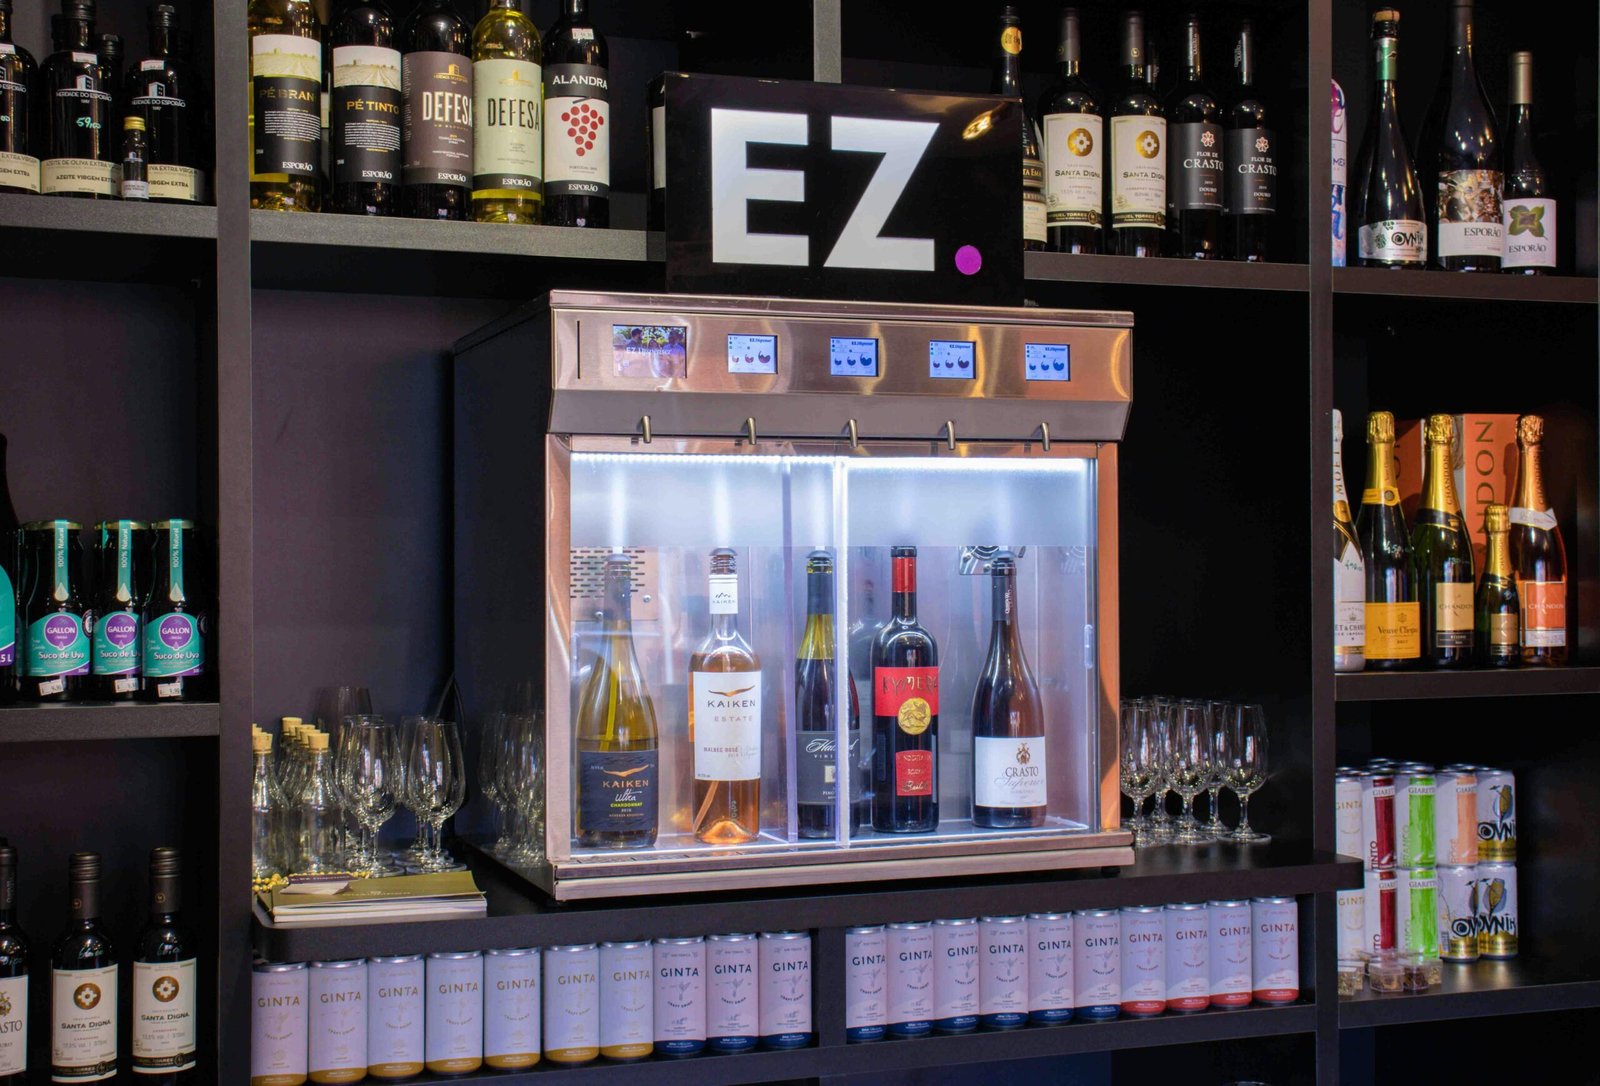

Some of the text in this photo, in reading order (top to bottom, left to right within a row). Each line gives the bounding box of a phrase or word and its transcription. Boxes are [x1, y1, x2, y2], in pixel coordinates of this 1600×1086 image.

[552, 75, 608, 90] ALANDRA
[278, 88, 314, 102] BRAN
[346, 98, 400, 114] PÉ TINTO
[422, 91, 472, 128] DEFESA
[488, 98, 540, 132] DEFESA
[282, 162, 313, 172] ESPORÃO
[1184, 159, 1224, 172] CRASTO
[1238, 164, 1277, 176] CRASTO
[362, 170, 392, 180] ESPORÃO
[438, 173, 466, 182] ESPORÃO
[1151, 172, 1164, 180] DIGN
[502, 178, 532, 187] ESPORÃO
[568, 184, 598, 192] ESPORÃO
[1464, 228, 1501, 237] ESPORÃO
[1508, 244, 1546, 253] ESPORÃO
[1443, 455, 1452, 505] CHANDON
[1378, 626, 1398, 634] Veuve
[708, 700, 756, 708] KAIKEN
[1005, 766, 1039, 777] CRASTO
[602, 780, 649, 788] KAIKEN
[615, 788, 642, 802] Ultra
[1338, 896, 1365, 906] GINT
[1220, 926, 1250, 936] GINTA
[1261, 923, 1295, 933] GINTA
[1129, 933, 1163, 943] GINTA
[1176, 930, 1208, 940] GINTA
[1038, 940, 1072, 950] GINTA
[1085, 937, 1118, 947] GINTA
[947, 947, 978, 957] GINTA
[989, 944, 1024, 954] GINTA
[852, 955, 885, 966] GINTA
[900, 951, 932, 961] GINTA
[715, 964, 752, 974] GINTA
[773, 961, 808, 971] GINTA
[614, 971, 650, 982] GINTA
[661, 968, 699, 977] GINTA
[497, 979, 536, 990] GINTA
[558, 974, 595, 985] GINTA
[378, 987, 418, 998] GINTA
[439, 983, 479, 994] GINTA
[258, 996, 300, 1008] GINTA
[320, 991, 362, 1003] GINTA
[167, 1012, 190, 1020] DIGNA
[89, 1019, 111, 1028] DIGNA
